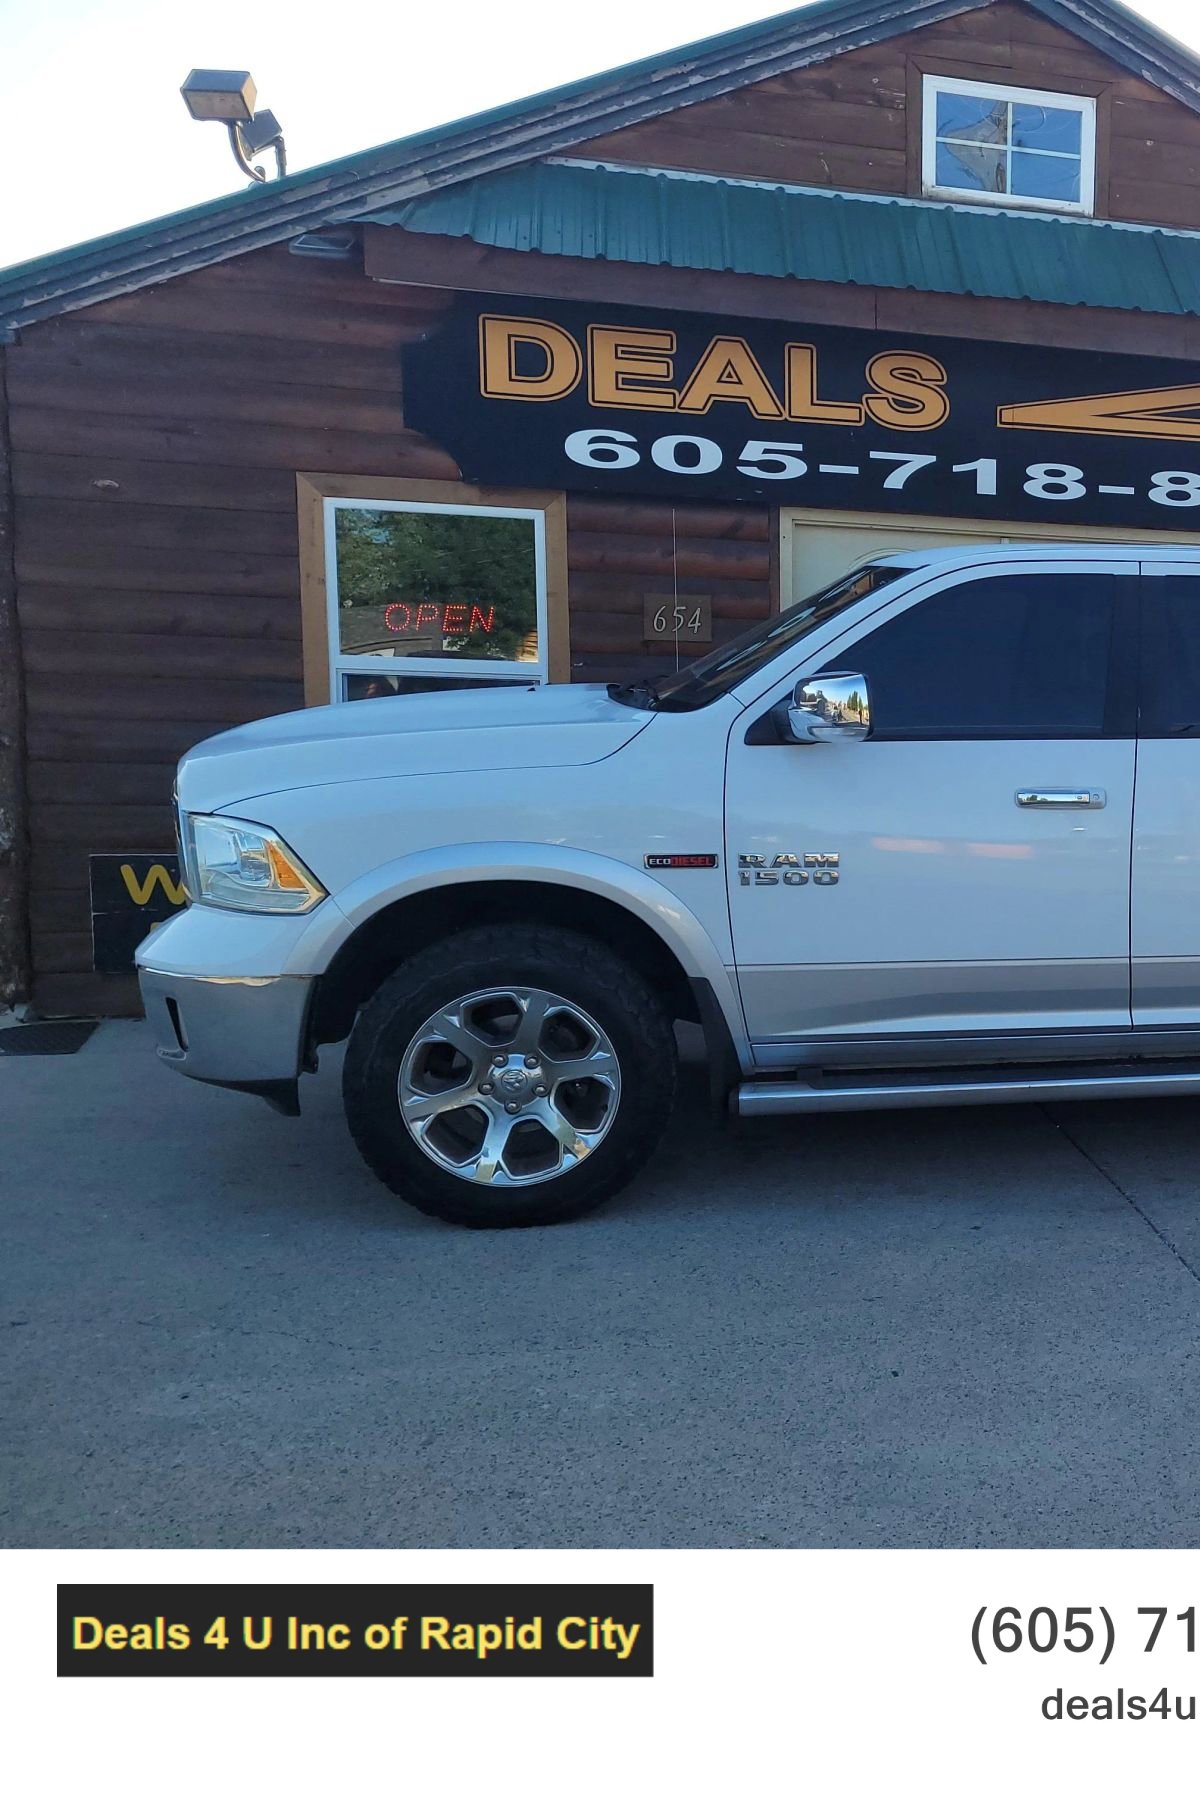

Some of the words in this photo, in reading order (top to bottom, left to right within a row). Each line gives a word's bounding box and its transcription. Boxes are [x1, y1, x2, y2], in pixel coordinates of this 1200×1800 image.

[478, 313, 950, 432] DEALS
[383, 602, 497, 633] OPEN
[653, 605, 703, 634] 654
[738, 852, 840, 869] RAM
[738, 869, 840, 886] 1500
